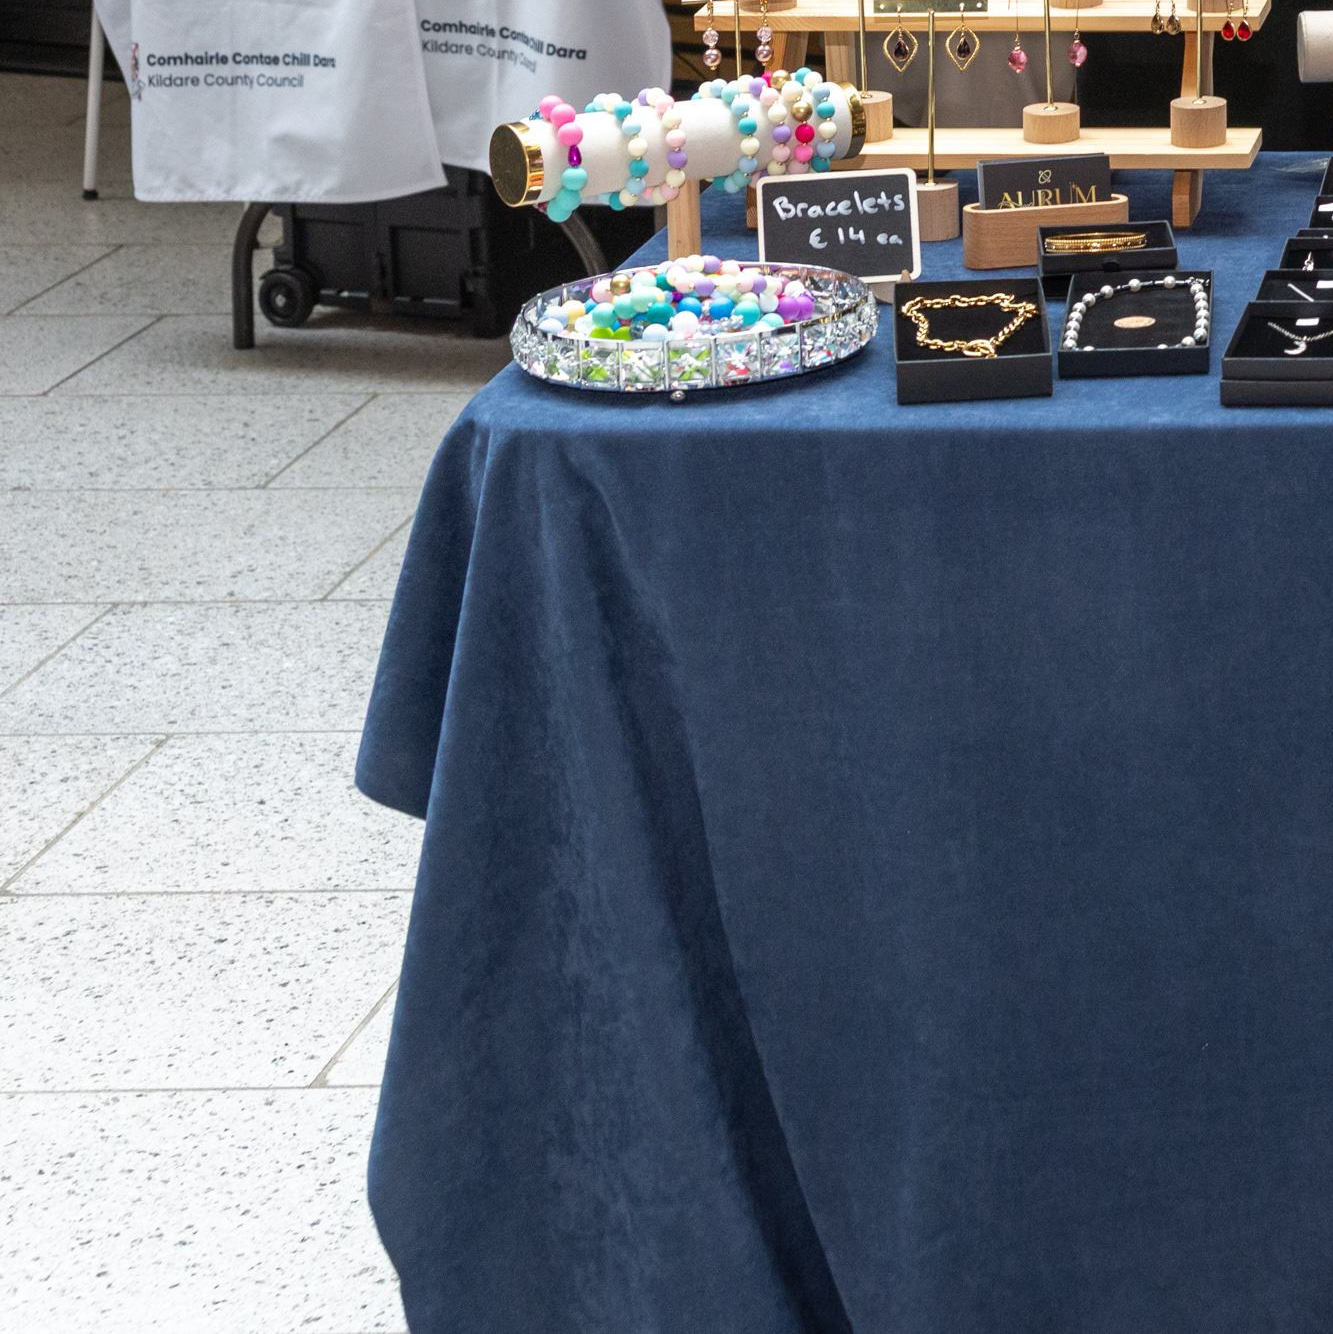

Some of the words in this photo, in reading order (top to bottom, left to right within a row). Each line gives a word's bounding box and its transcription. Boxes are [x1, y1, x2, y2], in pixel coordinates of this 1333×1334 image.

[146, 50, 229, 67] Comhairle
[232, 52, 280, 67] Contae
[282, 52, 311, 67] Chill
[545, 43, 588, 61] Dara
[147, 73, 200, 88] Kildare
[203, 73, 254, 90] County
[256, 73, 304, 88] Council
[773, 191, 906, 221] Bracelets
[876, 233, 903, 246] ea
